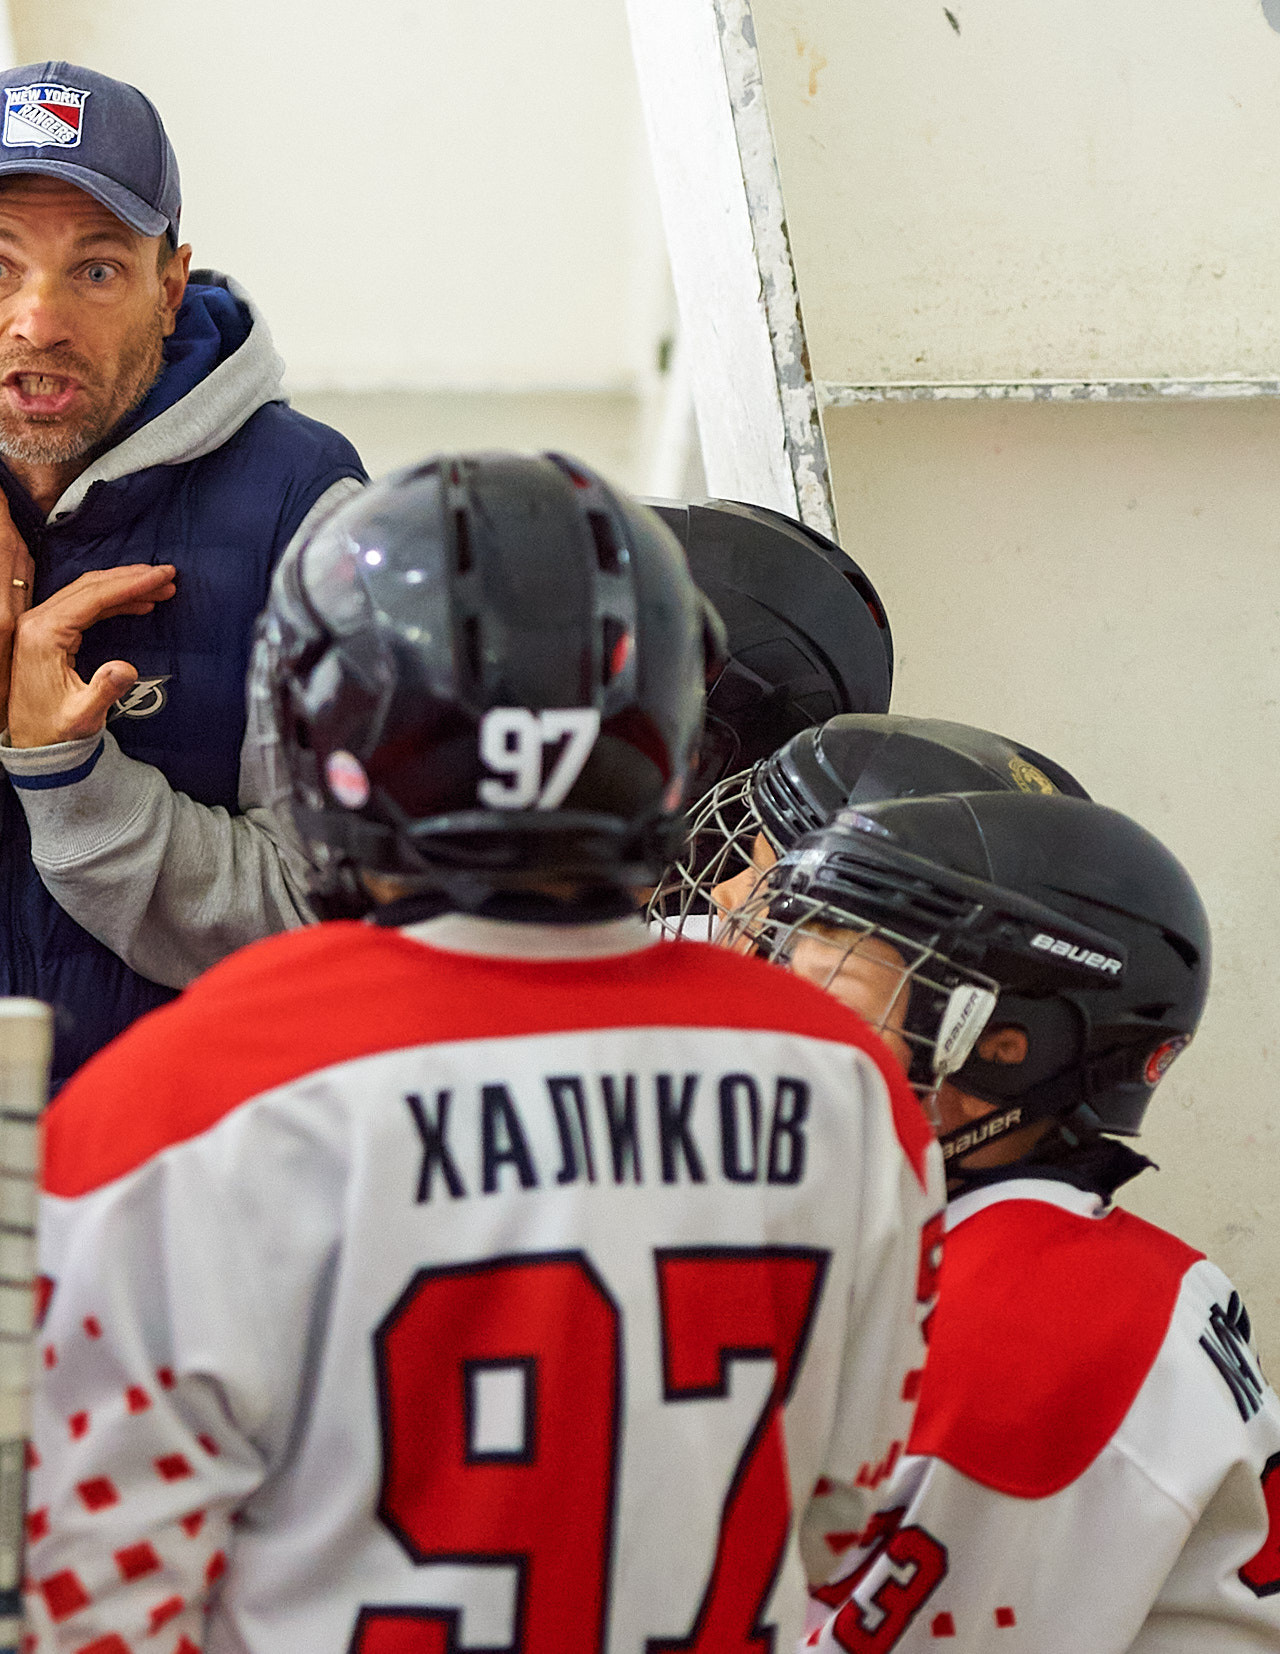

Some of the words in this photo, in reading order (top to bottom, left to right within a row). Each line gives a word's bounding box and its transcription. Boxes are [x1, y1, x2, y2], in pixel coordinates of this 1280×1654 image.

[10, 89, 41, 103] NEW
[44, 89, 80, 106] YORK
[18, 104, 75, 143] RANGERS
[477, 706, 601, 810] 97
[1030, 933, 1122, 975] BAUER
[944, 991, 978, 1052] BAUER
[406, 1072, 812, 1204] ХАЛИКОВ
[347, 1244, 833, 1654] 97
